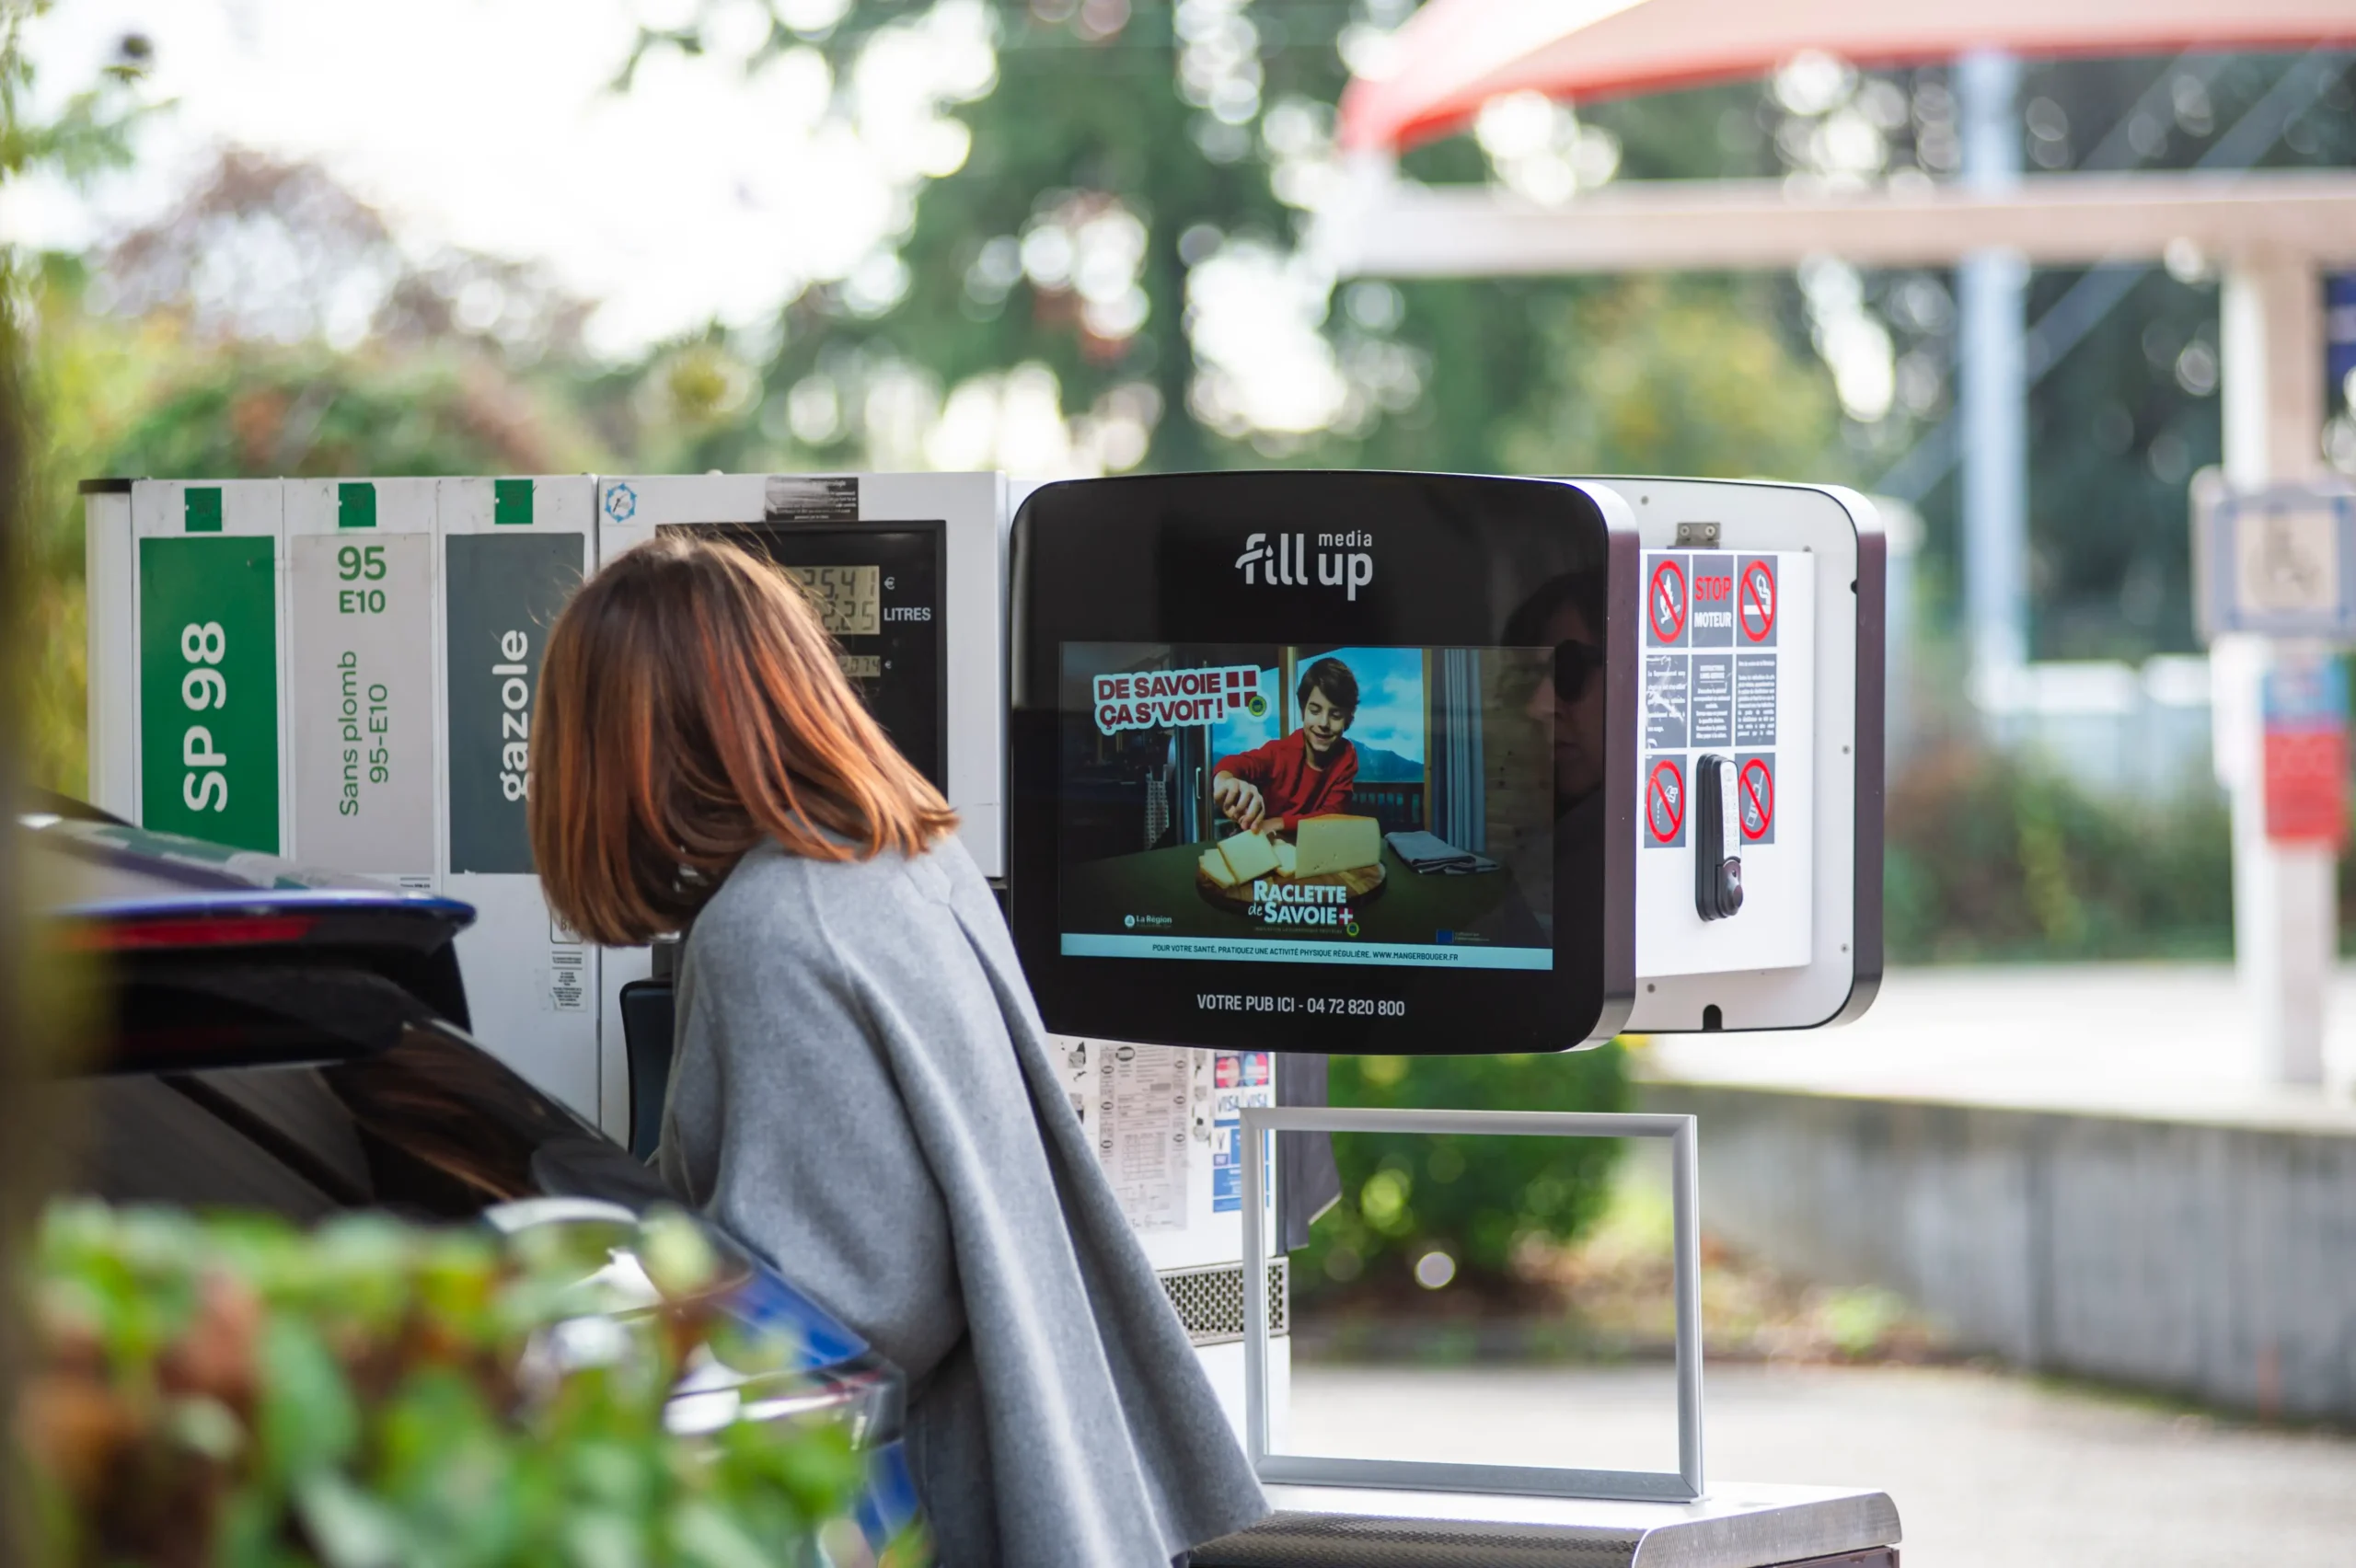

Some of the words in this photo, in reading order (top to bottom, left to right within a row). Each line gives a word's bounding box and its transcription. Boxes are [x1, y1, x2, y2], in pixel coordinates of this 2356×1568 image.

[1318, 529, 1372, 547] media
[337, 545, 387, 581] 95
[1234, 533, 1309, 585] fill
[1318, 552, 1373, 601] up
[339, 589, 386, 614] E10
[1694, 576, 1731, 601] STOP
[884, 607, 931, 621] LITRES
[1693, 612, 1732, 628] MOTEUR
[181, 621, 226, 711] 98
[337, 651, 363, 742] plomb
[1098, 678, 1130, 700] DE
[1134, 673, 1221, 699] SAVOIE
[492, 629, 532, 801] gazole
[1099, 704, 1134, 730] ÇA
[368, 684, 388, 783] 95-E10
[183, 725, 228, 813] SP
[339, 748, 359, 816] Sans
[1253, 880, 1347, 904] RACLETTE
[1248, 903, 1263, 917] de
[1264, 902, 1337, 925] SAVOIE
[1218, 946, 1253, 955] PRATIQUEZ
[1269, 948, 1299, 956] ACTIVITÉ
[1299, 949, 1332, 957] PHYSIQUE
[1372, 951, 1459, 961] WWW.MANGERBOUGER.FR
[1196, 994, 1242, 1010] VOTRE
[1245, 996, 1274, 1011] PUB
[1277, 997, 1295, 1012] ICI
[1307, 997, 1325, 1013] 04
[1328, 998, 1345, 1014] 72
[1347, 999, 1374, 1015] 820
[1378, 1000, 1405, 1016] 800
